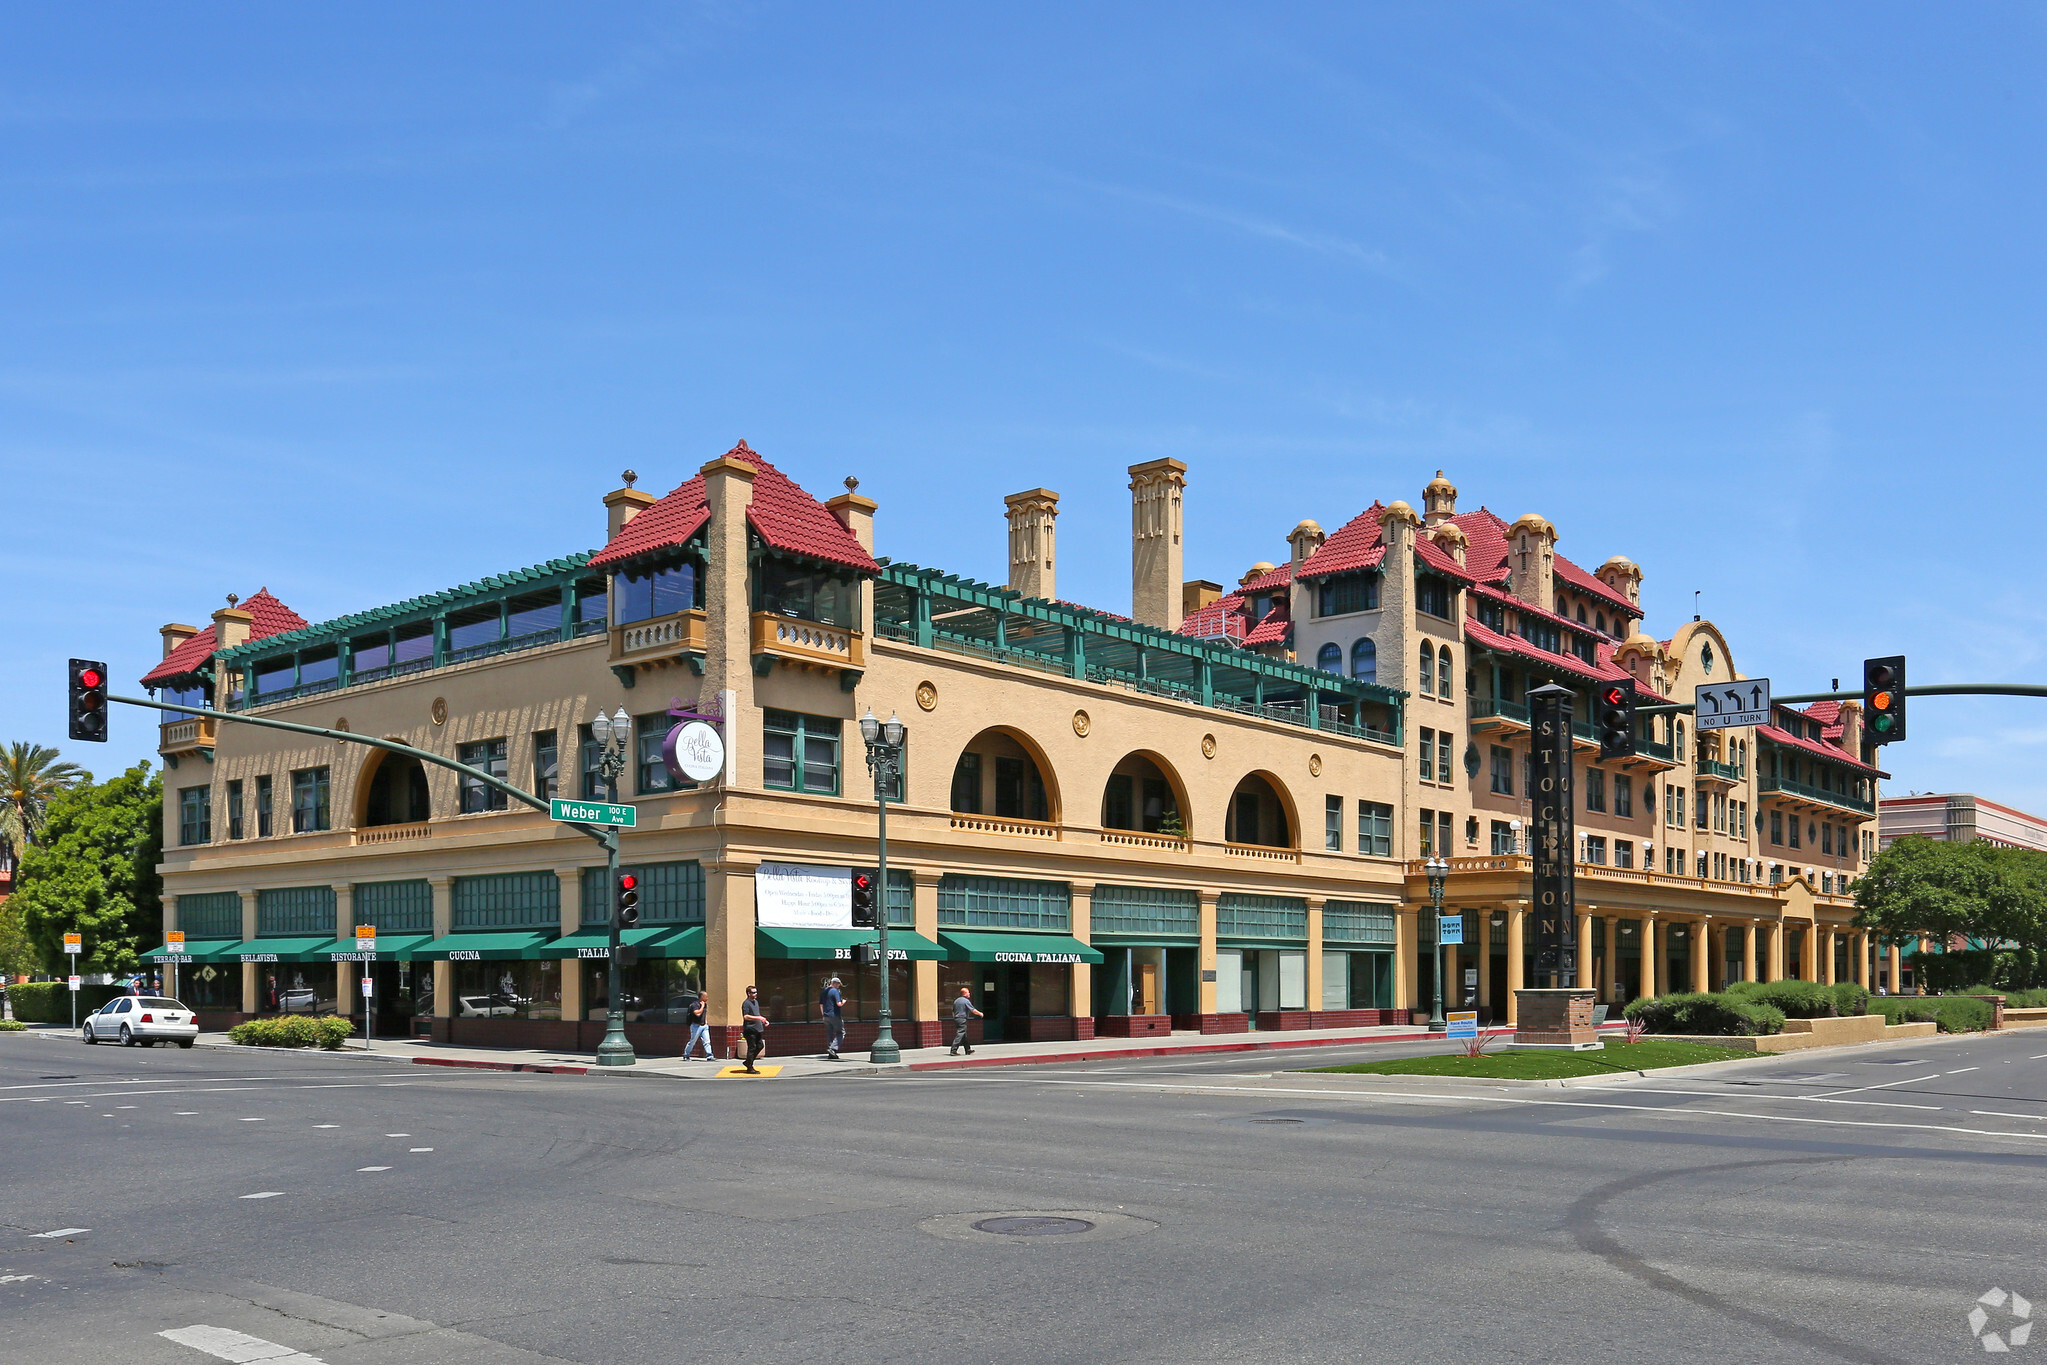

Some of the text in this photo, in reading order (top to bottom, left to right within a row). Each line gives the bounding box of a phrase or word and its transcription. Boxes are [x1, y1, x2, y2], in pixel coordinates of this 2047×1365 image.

[1704, 714, 1761, 726] NO U TURN
[682, 730, 711, 751] Bella
[688, 744, 714, 763] Vista
[560, 803, 600, 820] Weber
[608, 807, 627, 816] 100 E
[1540, 721, 1555, 934] STOCKTON
[1561, 721, 1570, 935] STOCKTON
[240, 954, 278, 962] BELLAVISTA
[331, 952, 377, 962] RISTORANTE
[449, 951, 480, 960] CUCINA
[995, 952, 1081, 963] CUCINA ITALIANA
